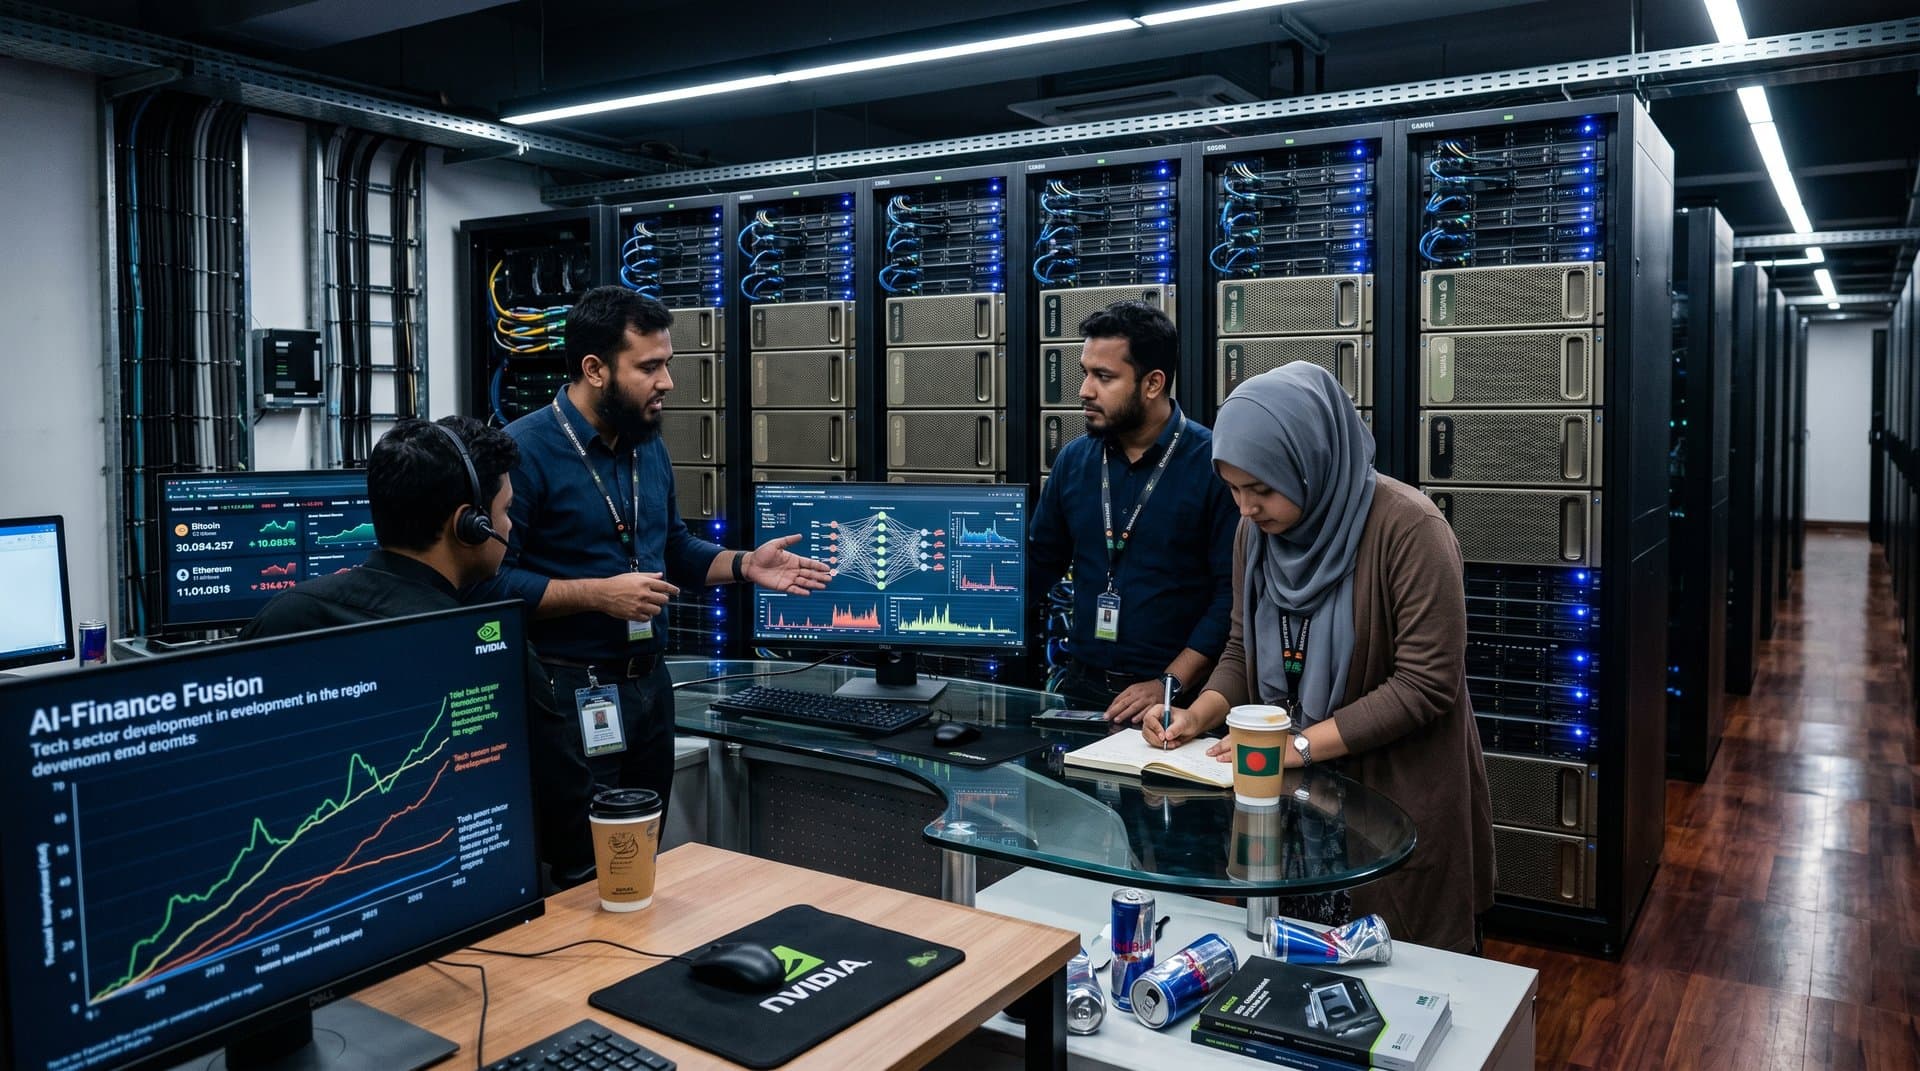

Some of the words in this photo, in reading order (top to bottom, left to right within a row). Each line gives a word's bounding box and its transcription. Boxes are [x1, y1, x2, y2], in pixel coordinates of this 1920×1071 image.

[191, 522, 220, 531] Bitcoin
[192, 565, 232, 575] Ethereum
[475, 641, 507, 655] NVIDIA
[29, 690, 177, 736] AI-Finance
[183, 676, 264, 708] Fusion
[30, 737, 69, 759] Tech
[73, 730, 119, 751] sector
[123, 713, 214, 740] development
[216, 708, 229, 723] in
[231, 694, 305, 720] evelopment
[306, 690, 317, 704] in
[320, 686, 339, 702] the
[341, 680, 377, 699] region
[759, 958, 869, 1014] NVIDIA
